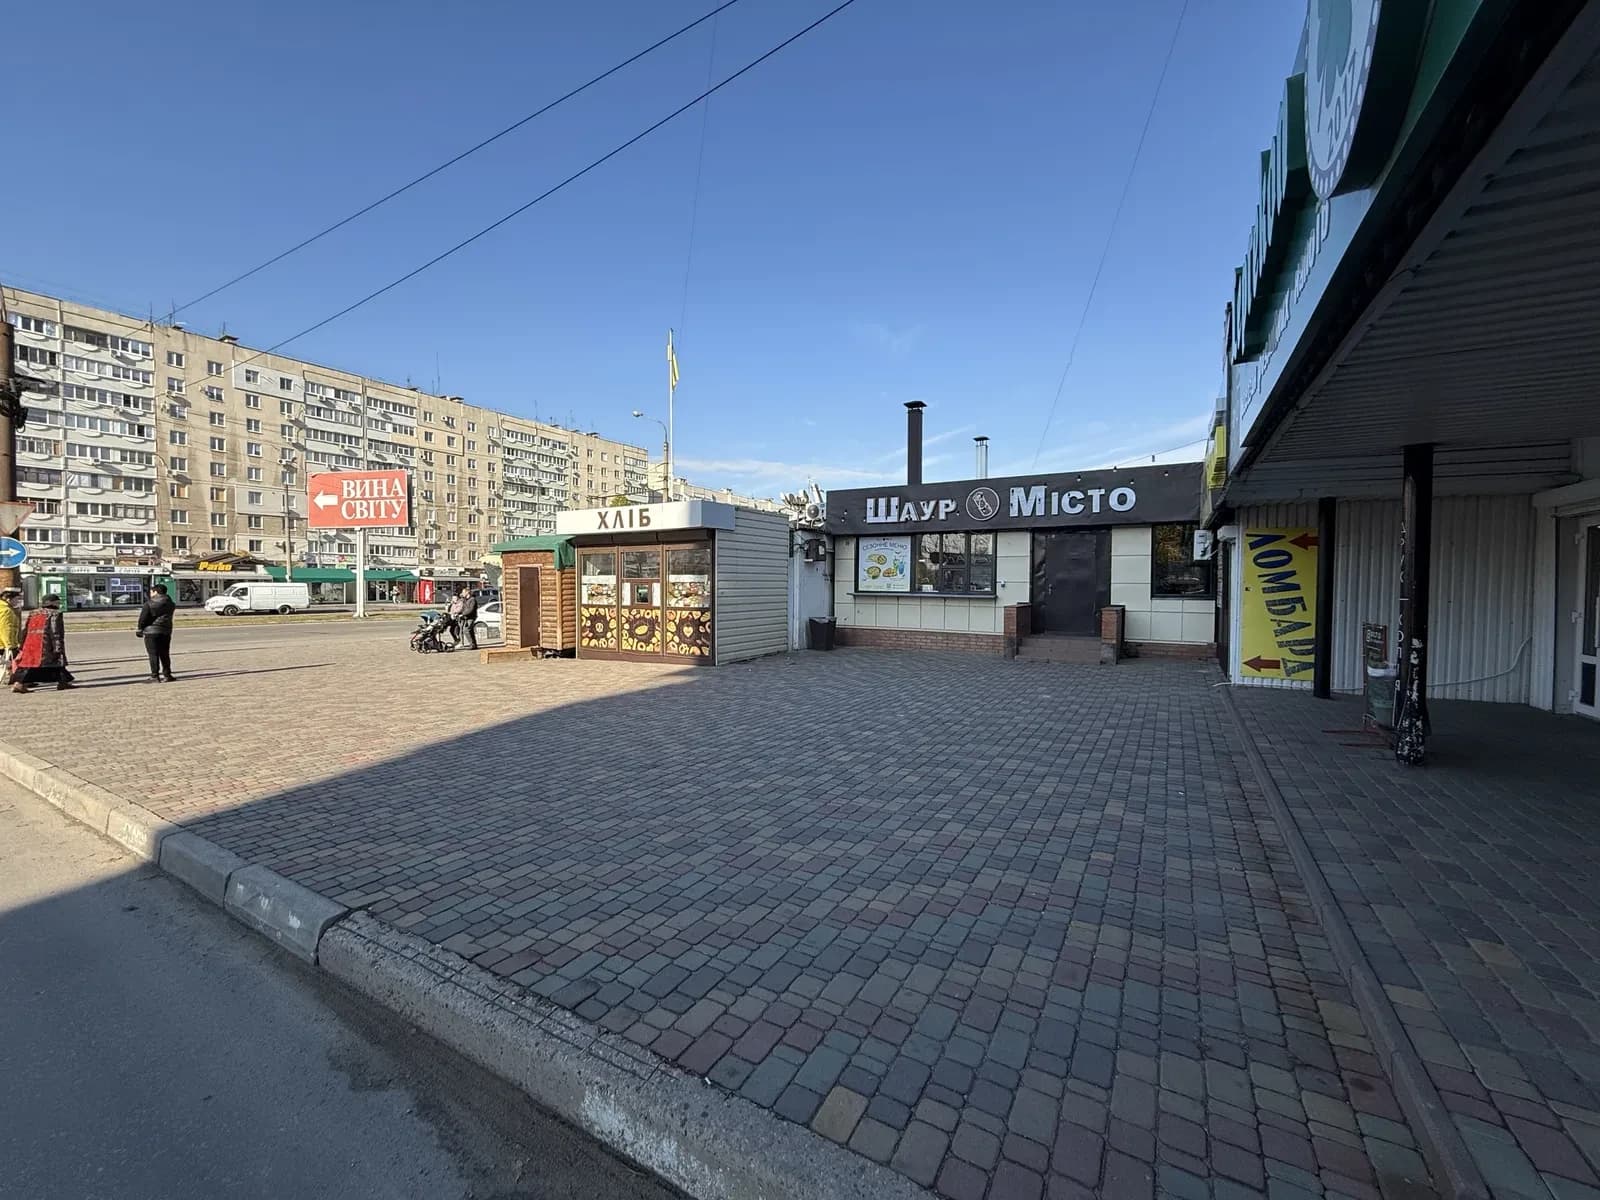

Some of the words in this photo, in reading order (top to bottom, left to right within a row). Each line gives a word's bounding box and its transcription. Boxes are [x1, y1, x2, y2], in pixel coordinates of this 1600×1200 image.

[341, 478, 406, 499] ВИНА
[341, 498, 406, 520] СВІТУ
[597, 507, 652, 530] ХЛІБ
[1246, 532, 1316, 677] ЛОМБАРД
